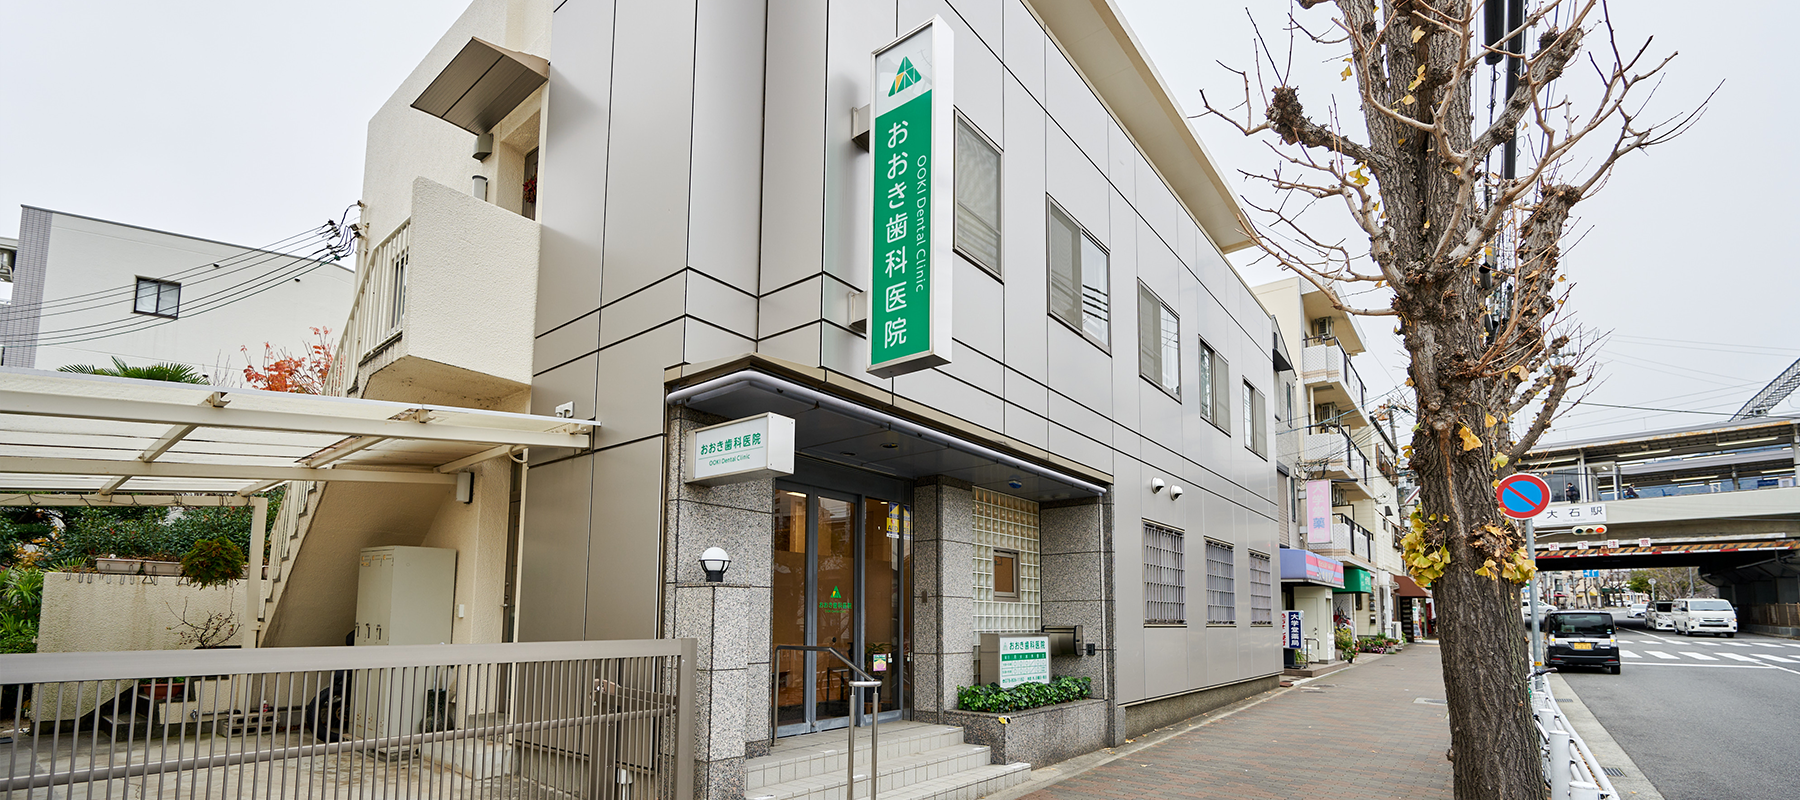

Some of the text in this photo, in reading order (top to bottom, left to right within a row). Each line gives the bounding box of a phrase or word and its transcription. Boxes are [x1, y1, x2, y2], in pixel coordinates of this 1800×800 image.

[916, 155, 927, 292] OOKI Dental Clinic
[885, 120, 908, 349] おおき歯科医院
[700, 432, 761, 455] おおき歯科医院
[721, 456, 736, 464] Dental
[737, 454, 750, 462] Clinic
[1547, 506, 1603, 519] 大石駅
[1009, 640, 1046, 650] おおき歯科医院
